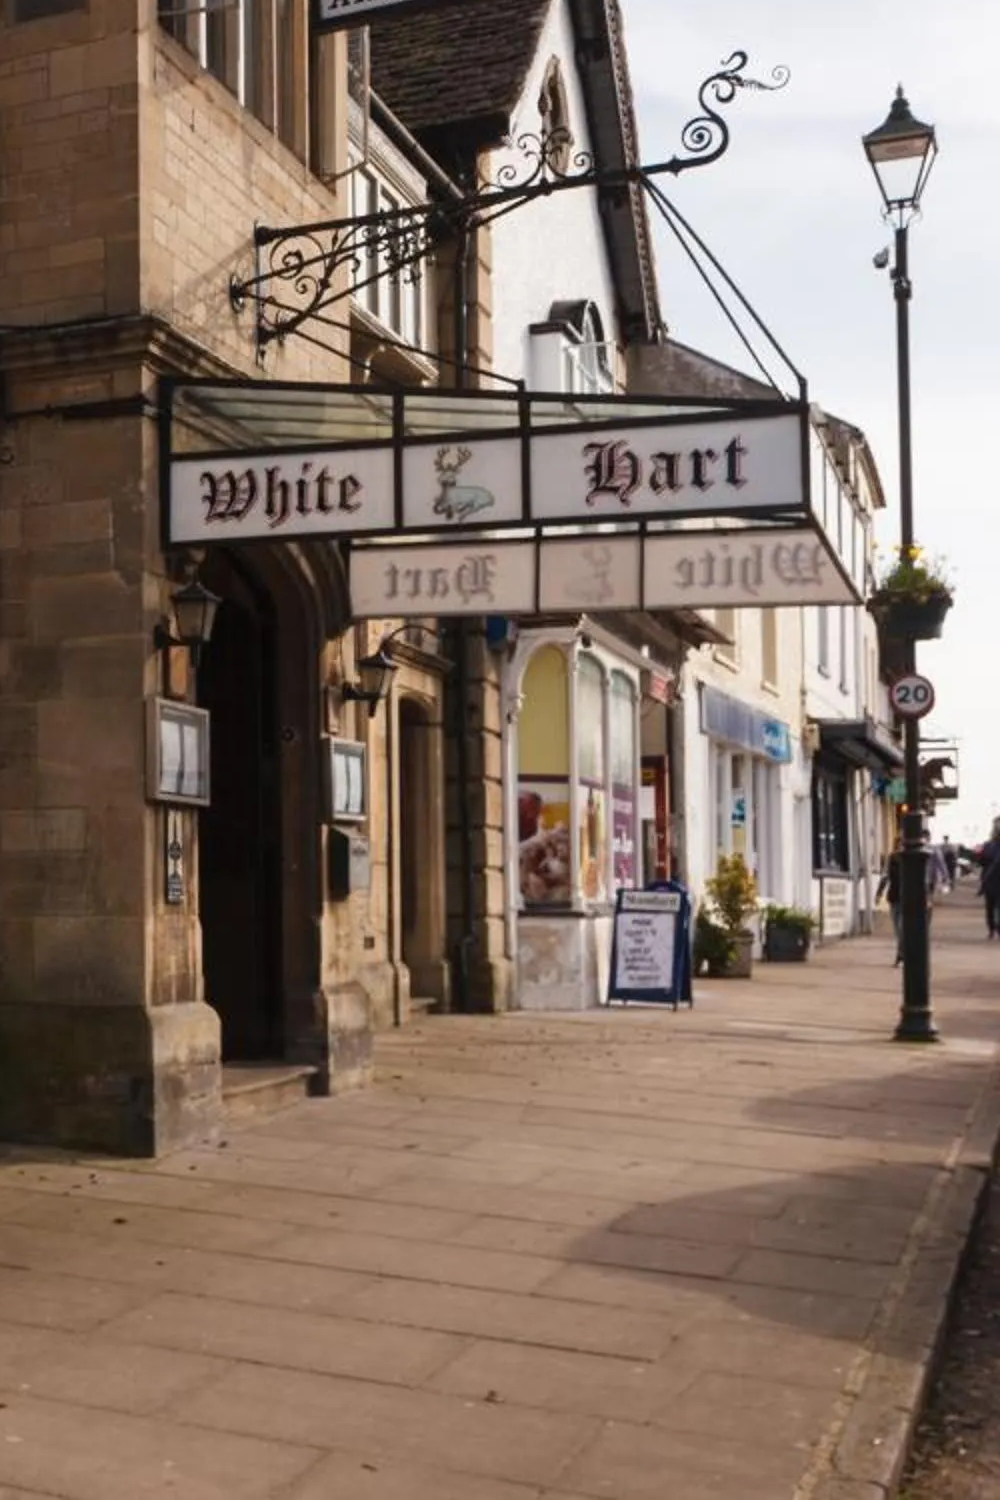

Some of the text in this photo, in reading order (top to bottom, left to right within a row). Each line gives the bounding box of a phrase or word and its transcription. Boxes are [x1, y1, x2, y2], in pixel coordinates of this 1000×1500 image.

[200, 436, 749, 528] White Hart
[896, 684, 929, 705] 20
